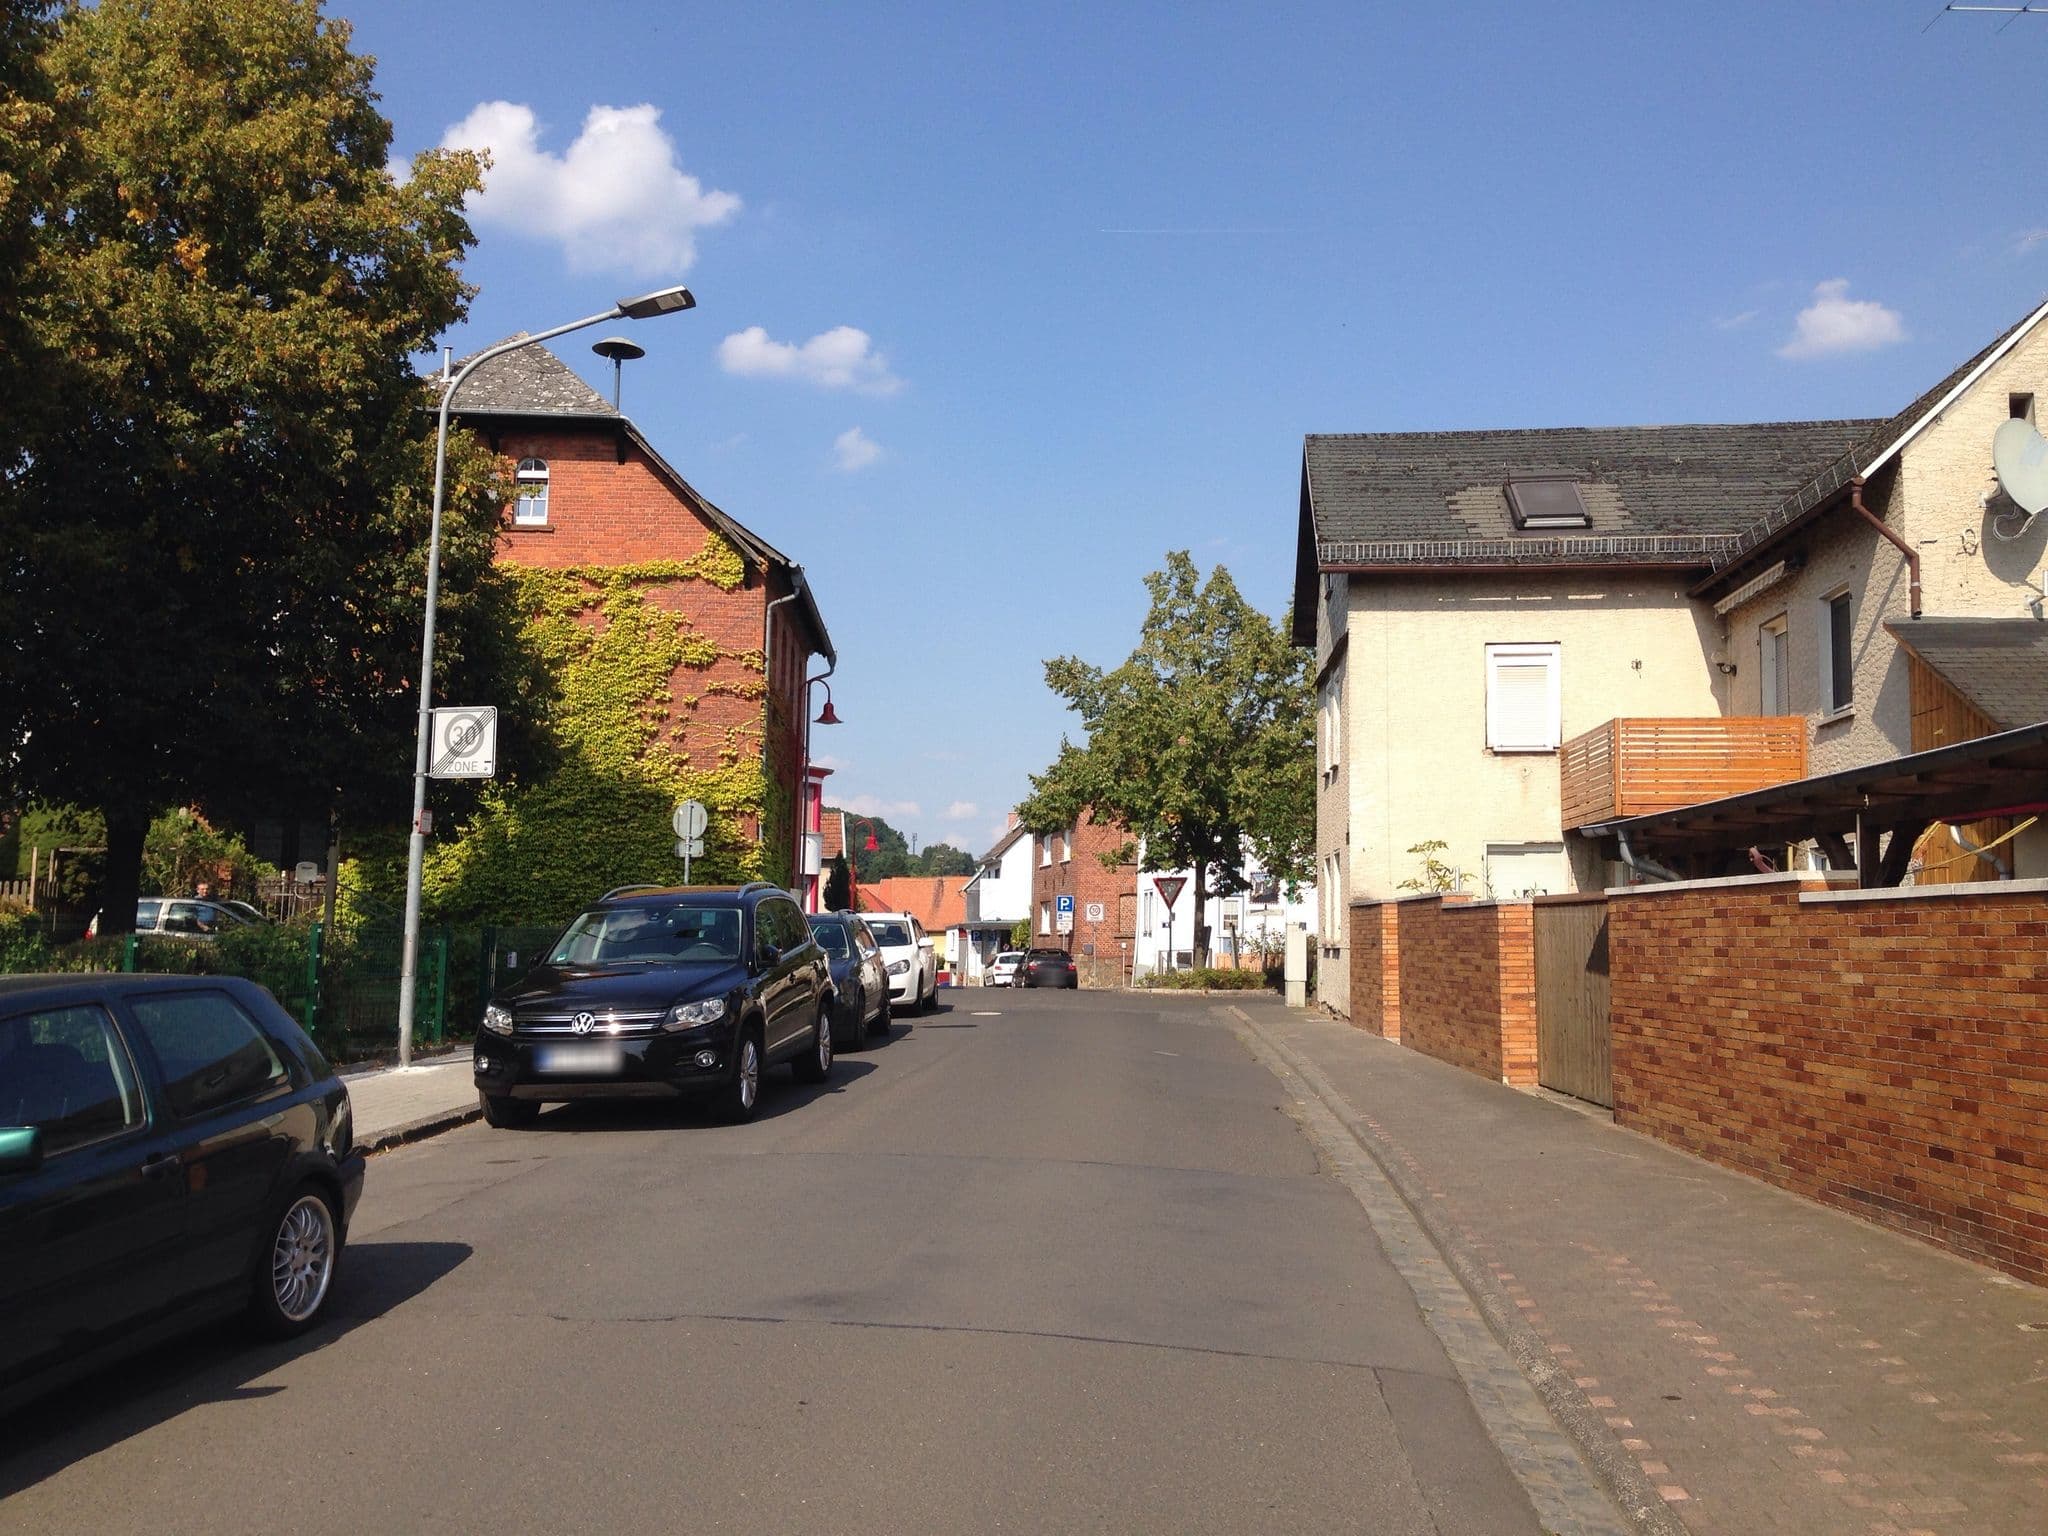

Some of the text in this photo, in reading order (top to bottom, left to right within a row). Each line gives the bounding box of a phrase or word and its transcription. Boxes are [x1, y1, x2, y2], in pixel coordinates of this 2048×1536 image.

[452, 725, 477, 745] 30
[447, 761, 479, 772] ZONE
[1060, 897, 1071, 910] P
